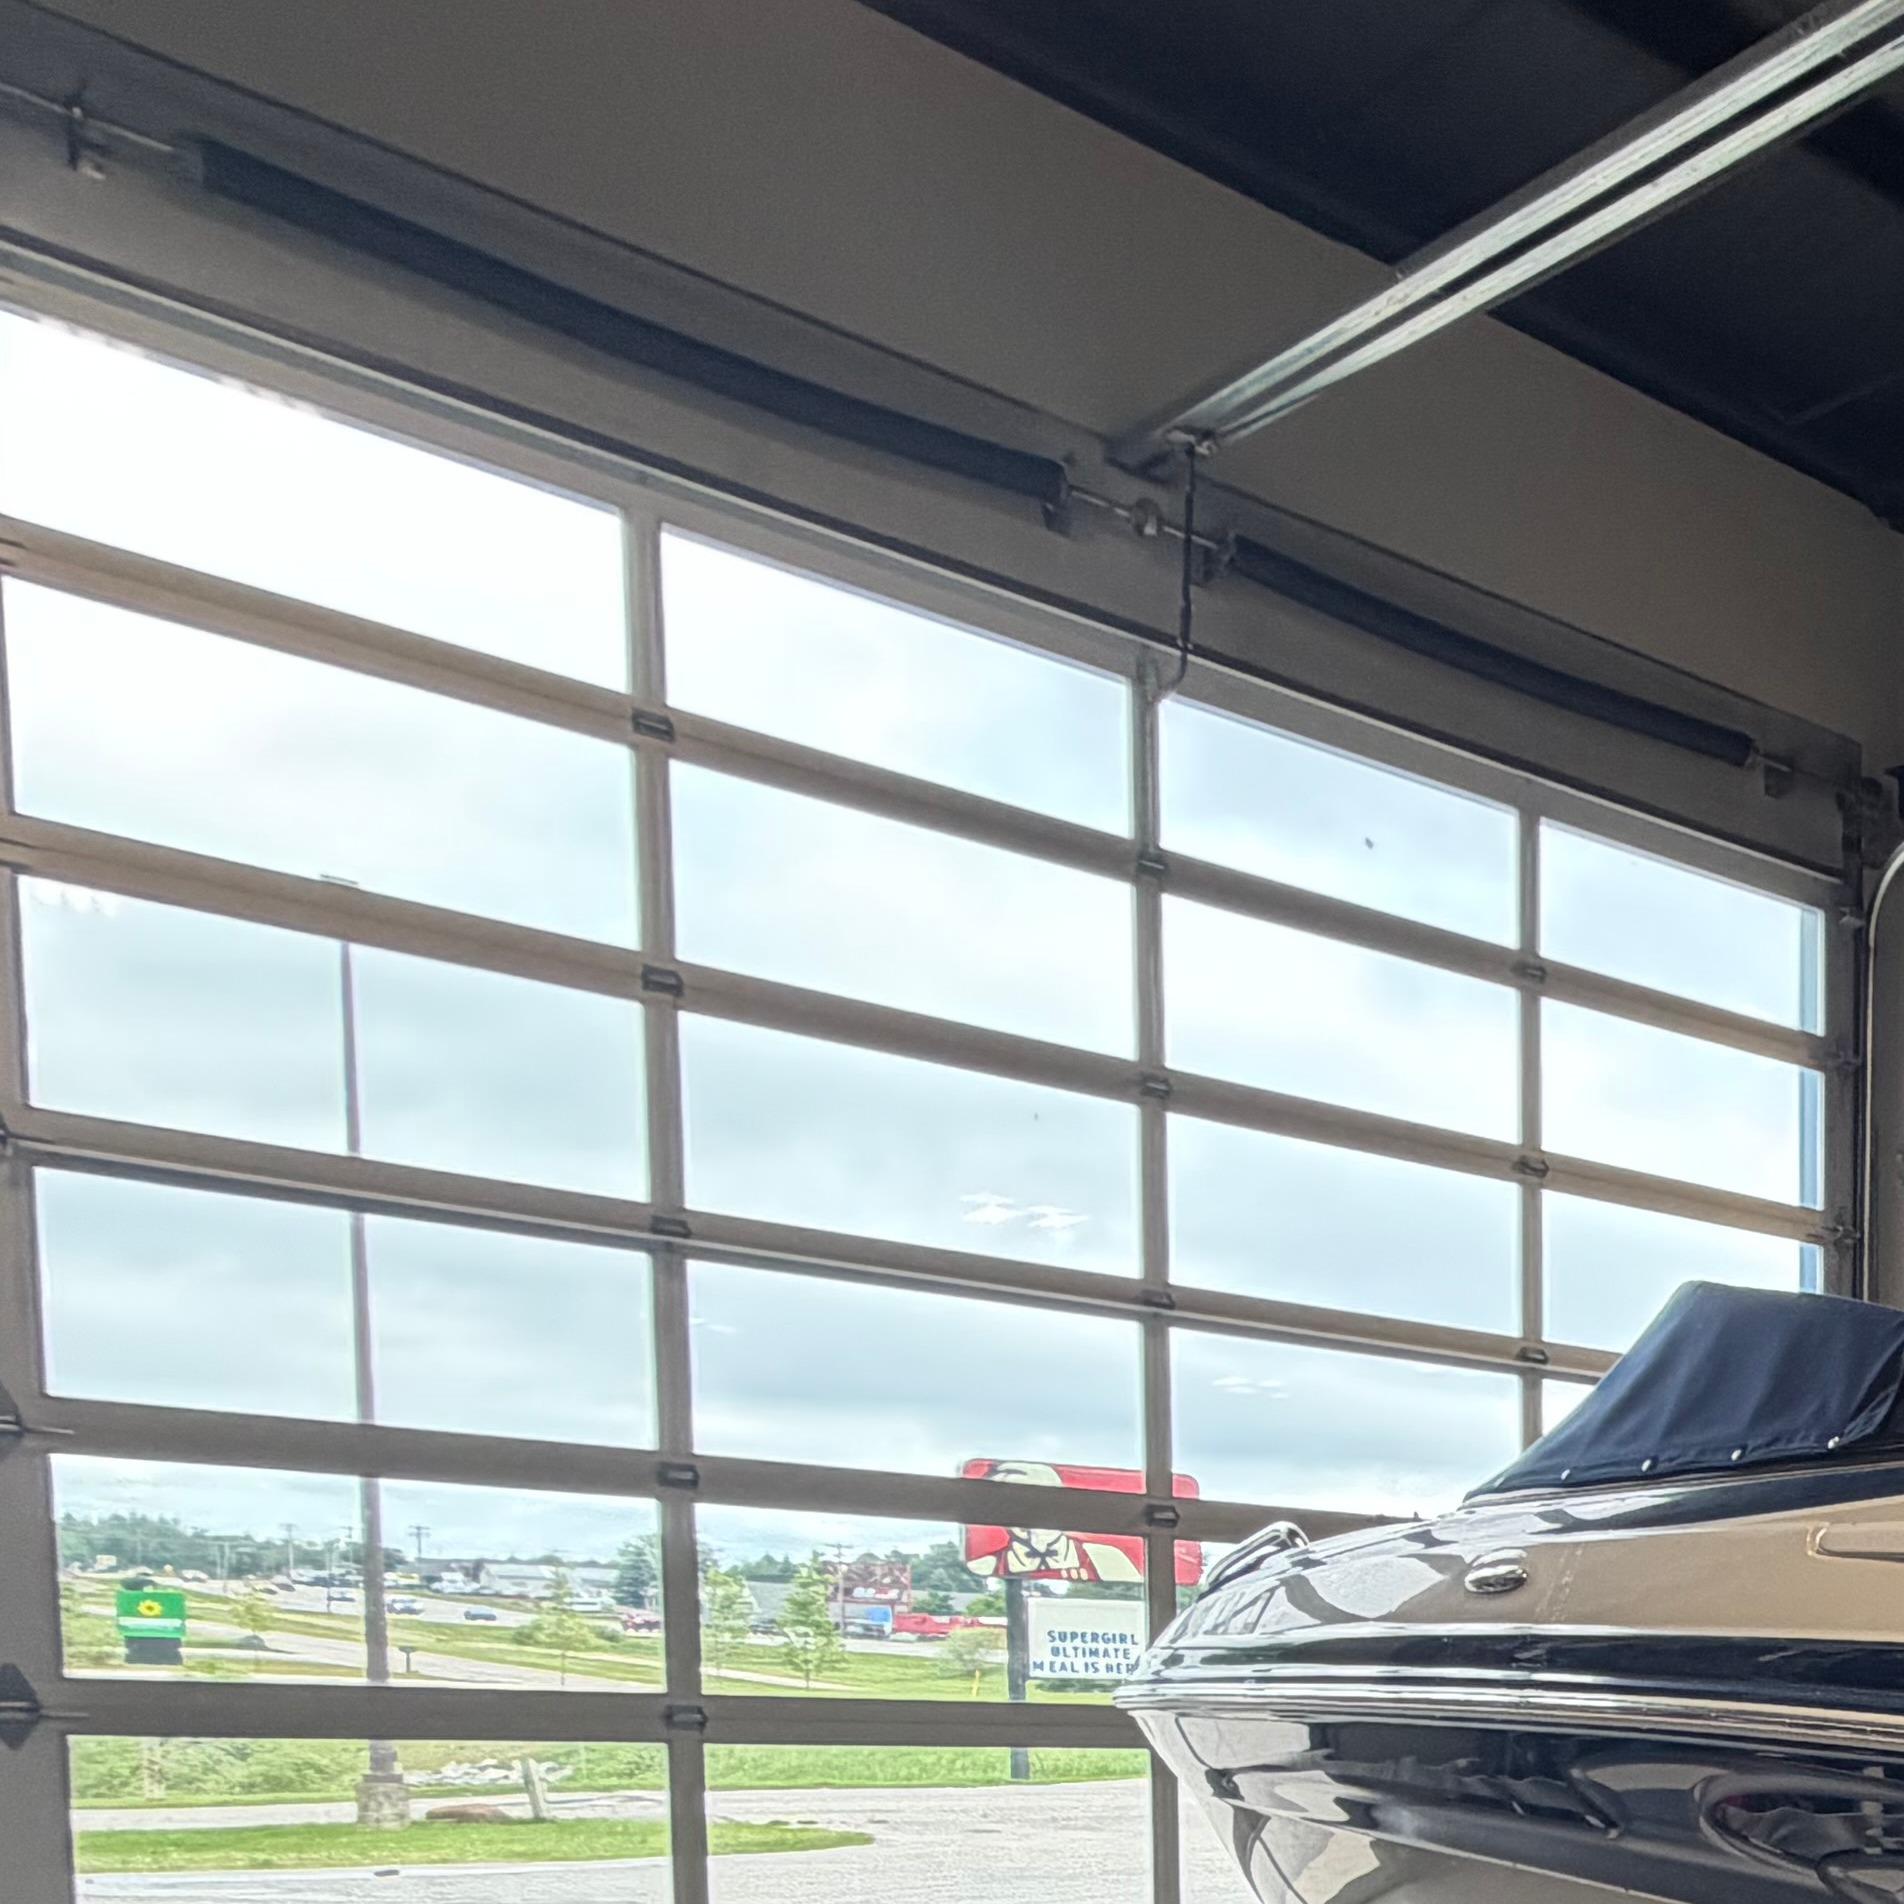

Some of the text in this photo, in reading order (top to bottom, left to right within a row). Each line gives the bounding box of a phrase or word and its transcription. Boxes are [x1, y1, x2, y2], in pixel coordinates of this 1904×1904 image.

[1047, 1630, 1139, 1645] SUPERGIRL
[1050, 1646, 1131, 1660] ULTIMATE
[1032, 1660, 1136, 1675] MEAL IS HER
